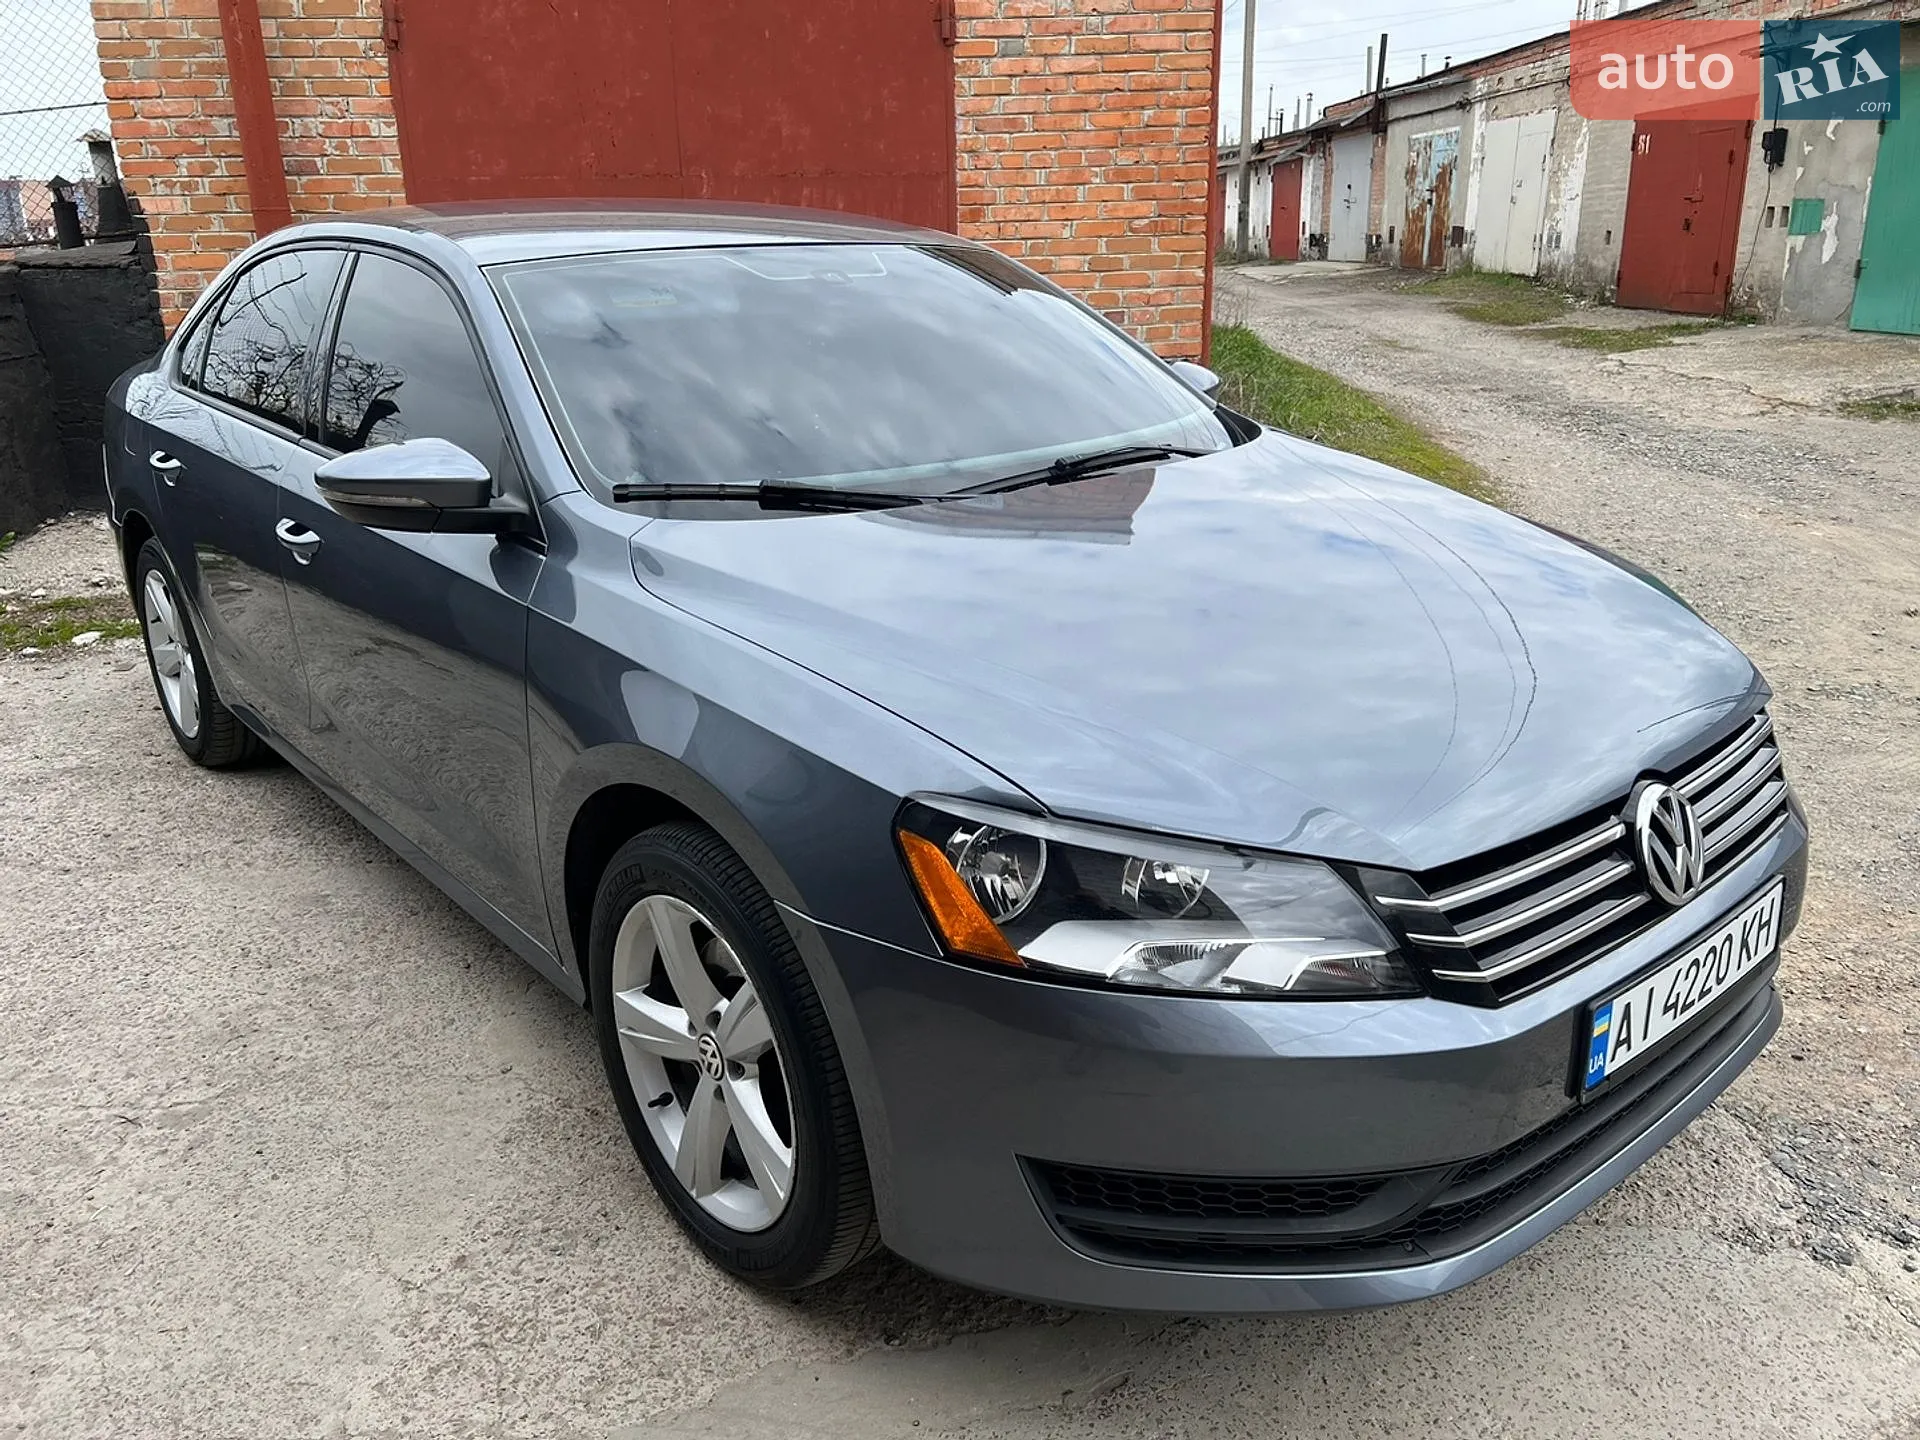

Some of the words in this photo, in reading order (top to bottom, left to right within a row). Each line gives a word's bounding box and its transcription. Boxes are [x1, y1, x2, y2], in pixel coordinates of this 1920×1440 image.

[1609, 986, 1655, 1063] AI
[1662, 932, 1734, 1021] 4220
[1736, 896, 1776, 972] KH
[1588, 1056, 1604, 1074] UA
